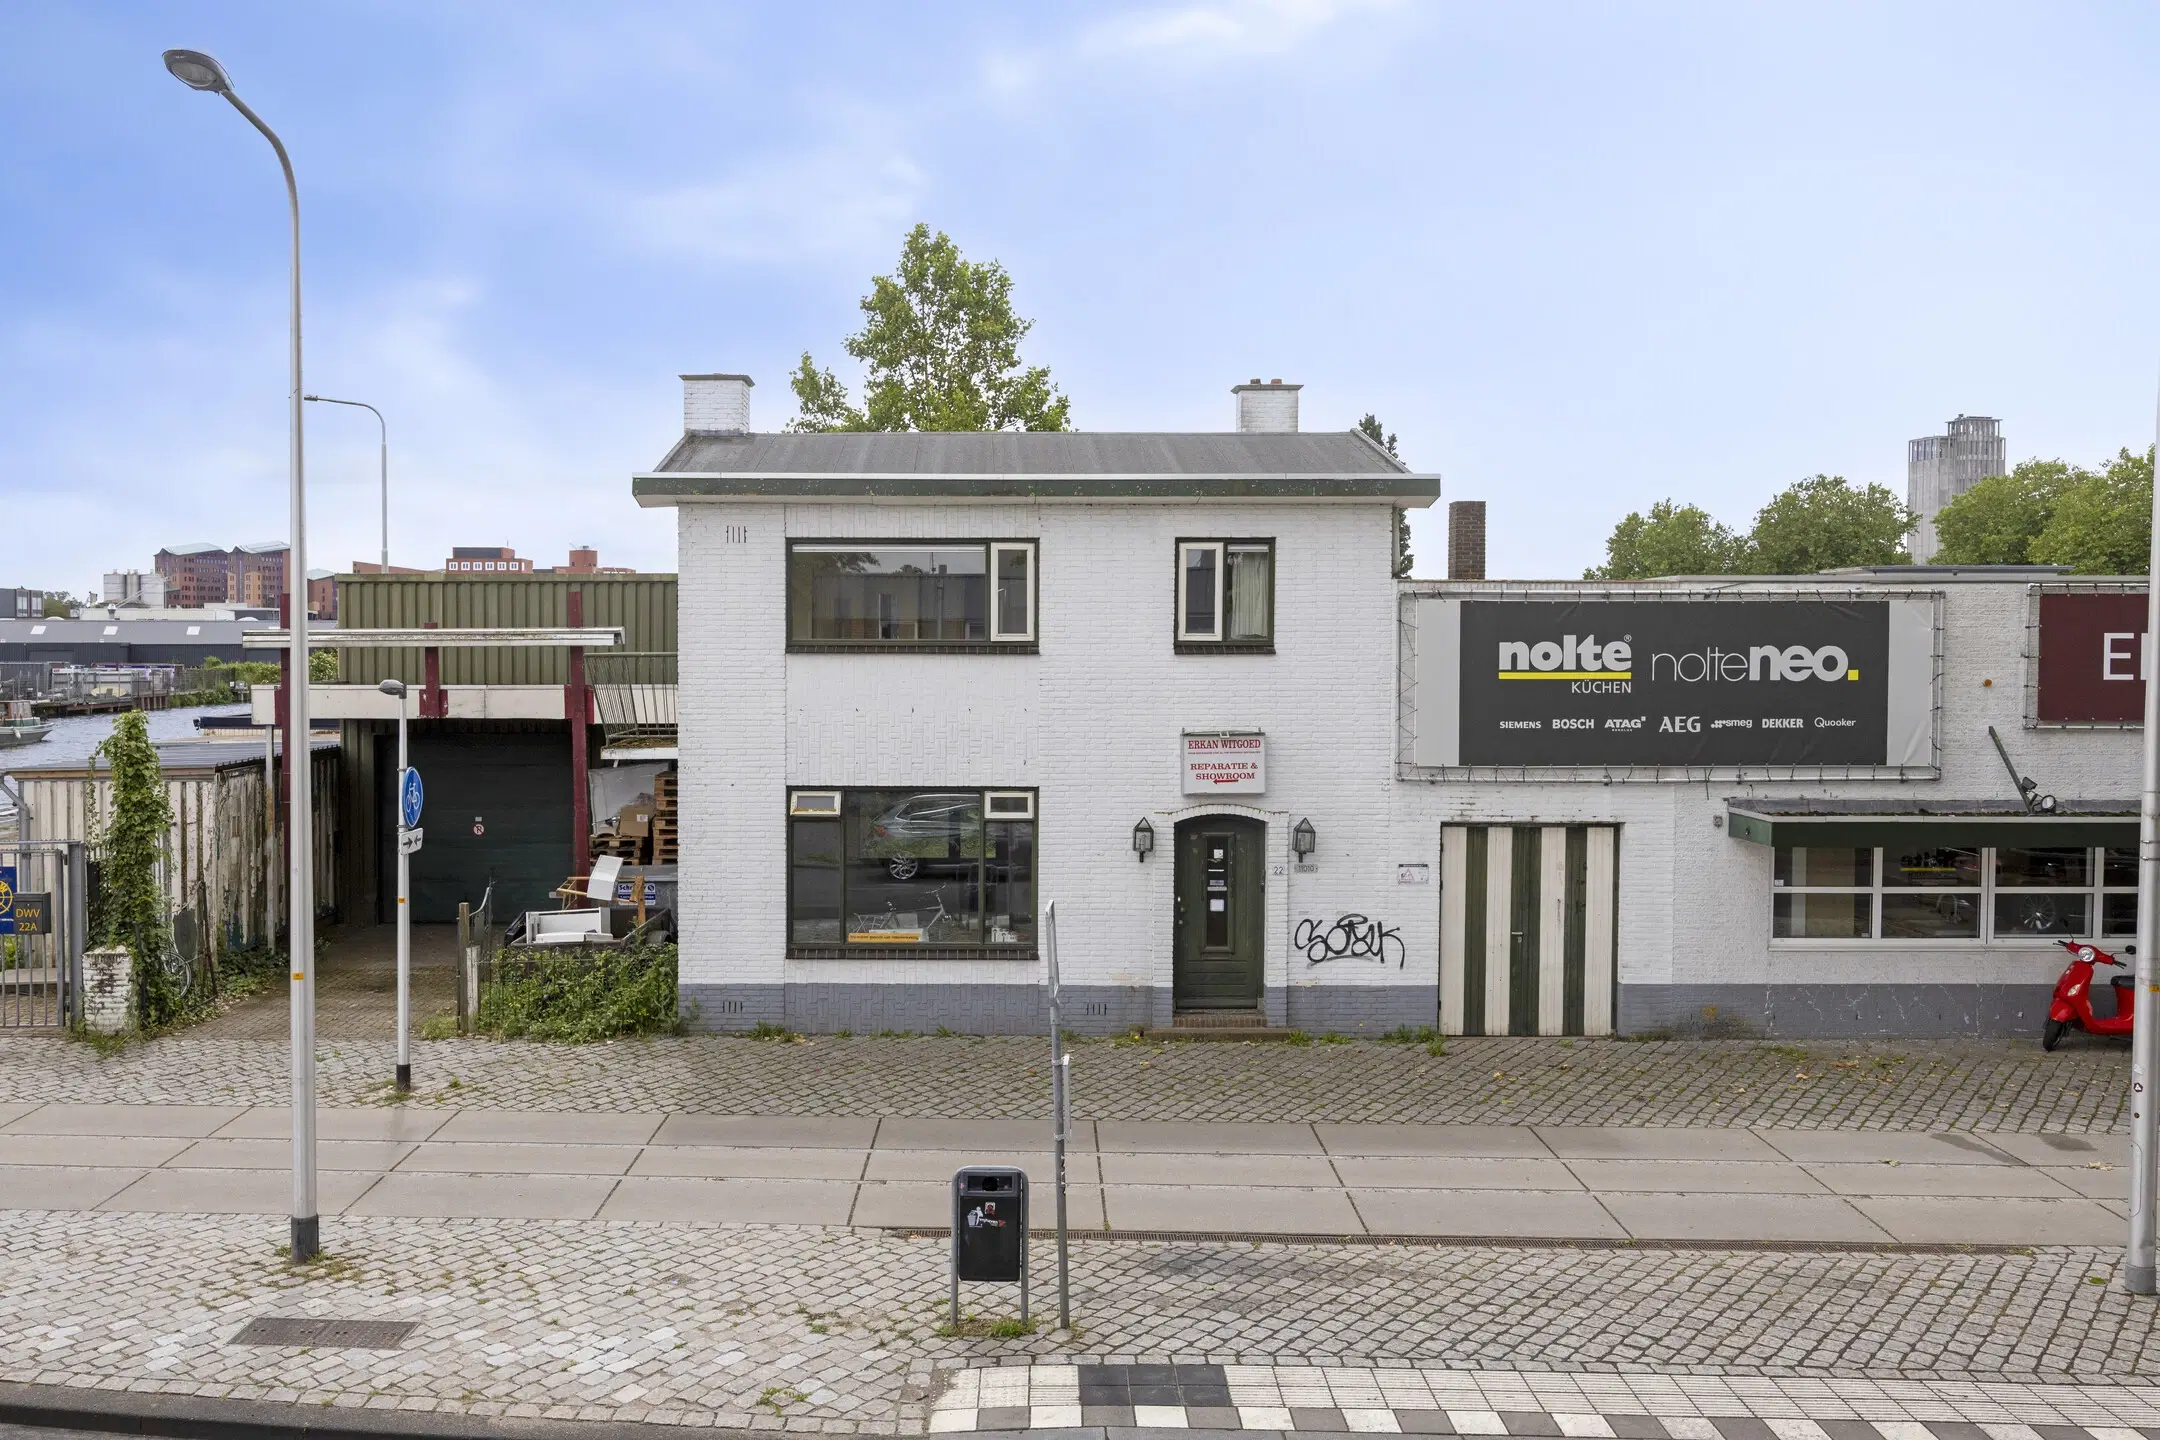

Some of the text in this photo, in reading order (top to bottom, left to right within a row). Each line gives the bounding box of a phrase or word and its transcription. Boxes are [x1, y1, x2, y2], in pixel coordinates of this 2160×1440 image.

[1571, 679, 1632, 694] KÜCHEN
[1500, 720, 1542, 729] SIEMENS
[1552, 718, 1595, 730] BOSCH
[1604, 718, 1642, 729] ATAG
[1659, 716, 1701, 733] AEG
[1762, 718, 1804, 729] DEKKER
[1814, 717, 1857, 728] Quooker
[1188, 739, 1261, 750] ERKAN WITGOED
[1190, 762, 1258, 771] REPARATIE &
[1195, 772, 1255, 780] SHOWROOM
[1273, 866, 1284, 875] 22
[15, 908, 41, 918] DWV
[19, 922, 38, 932] 22A
